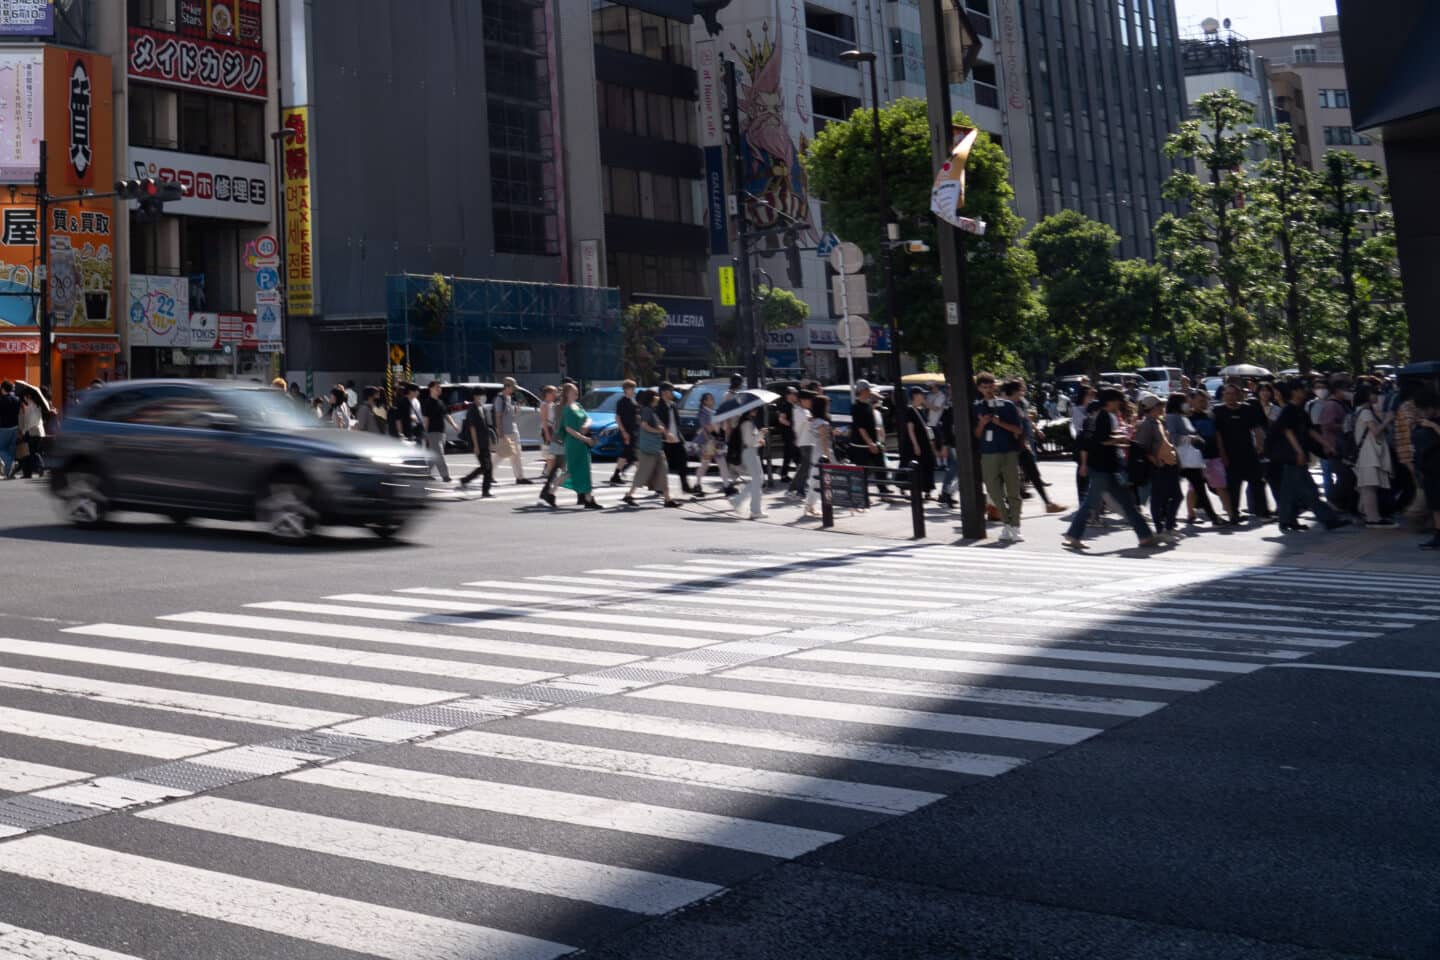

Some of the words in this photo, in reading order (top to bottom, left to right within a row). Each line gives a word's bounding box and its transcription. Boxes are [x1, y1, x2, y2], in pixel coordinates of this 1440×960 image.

[132, 35, 262, 90] メイドカジノ
[299, 186, 308, 221] TAX
[53, 209, 111, 234] 質&買取
[260, 241, 273, 253] 40
[300, 231, 310, 279] FREE
[260, 273, 270, 287] P
[662, 313, 705, 329] ALLERIA
